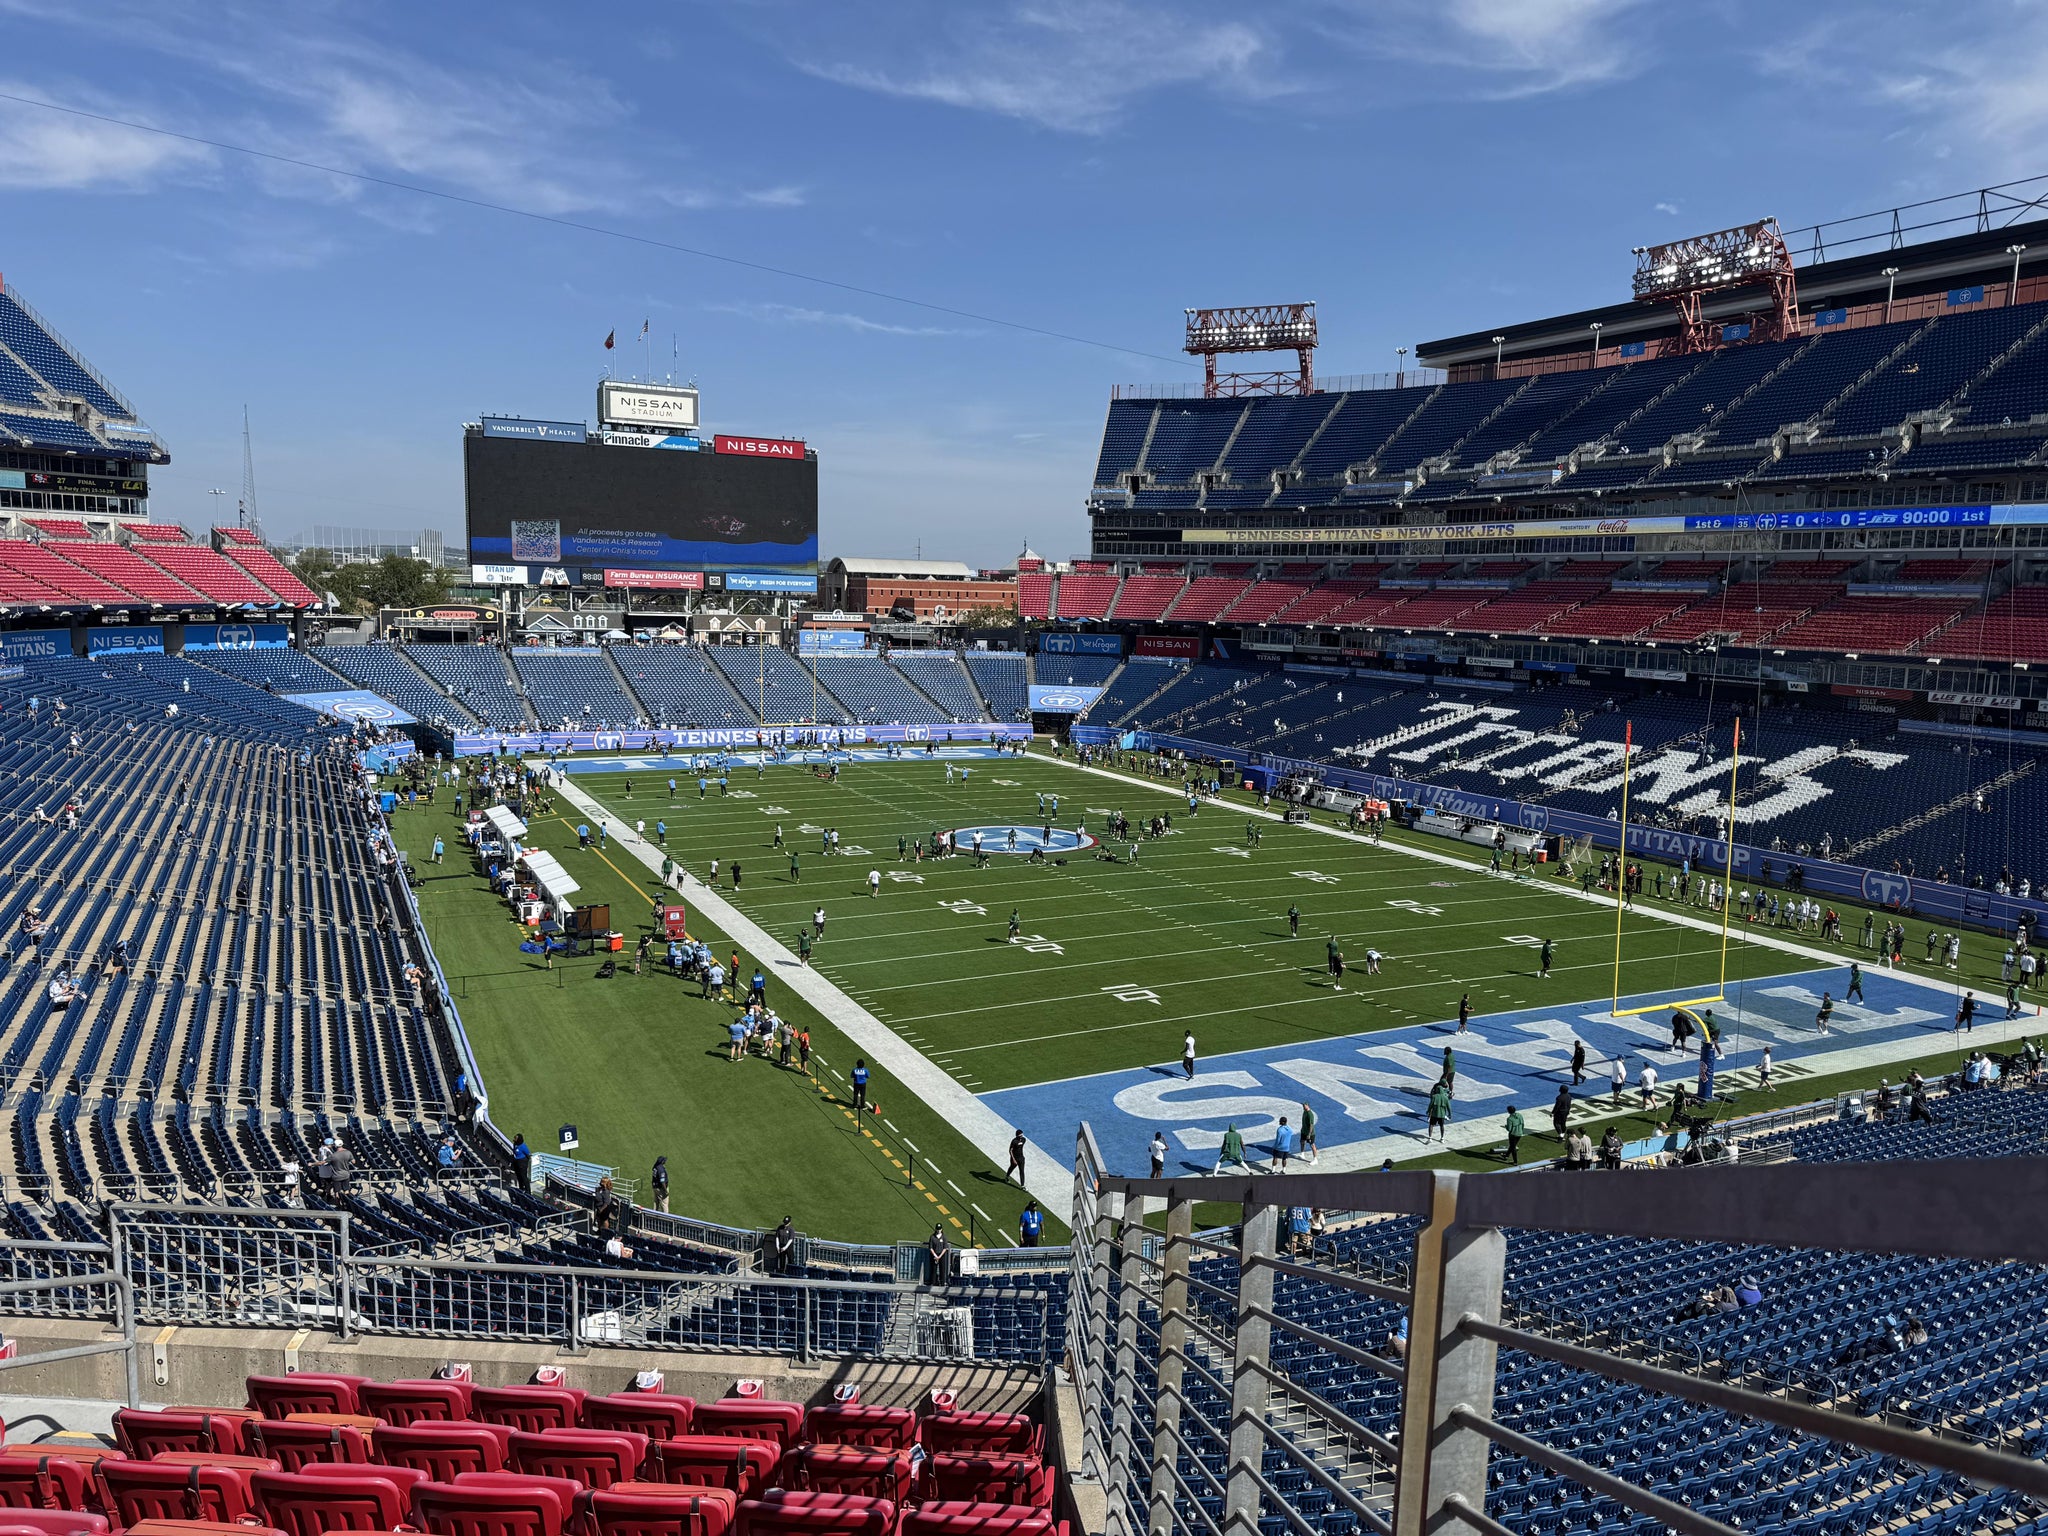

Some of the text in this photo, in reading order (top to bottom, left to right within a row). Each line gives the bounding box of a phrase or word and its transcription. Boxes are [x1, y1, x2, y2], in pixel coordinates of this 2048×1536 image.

[620, 397, 683, 411] NISSAN
[631, 408, 673, 417] STADIUM
[491, 425, 536, 434] VANDERBILT
[604, 432, 650, 446] Pinnacle
[727, 441, 794, 455] NISSAN
[1795, 515, 1805, 528] 0
[1841, 514, 1851, 526] 0
[1867, 512, 1898, 525] JETS
[1902, 511, 1950, 524] 90:00
[1961, 510, 1985, 521] 1st
[1695, 519, 1722, 529] 1st &
[1737, 520, 1749, 528] 35
[1226, 530, 1321, 541] TENNESSEE
[1324, 529, 1383, 541] TITANS
[1398, 527, 1438, 540] NEW
[1436, 525, 1476, 539] YORK
[1477, 524, 1515, 538] JETS
[610, 538, 627, 546] ALS
[627, 539, 663, 547] Research
[610, 547, 636, 555] Chris's
[484, 565, 506, 573] TITAN
[630, 572, 654, 580] Bureau
[11, 635, 46, 643] TENNESSEE
[93, 634, 159, 648] NISSAN
[1091, 637, 1117, 653] Kroger
[1144, 640, 1191, 649] NISSAN
[3, 642, 56, 658] TITANS
[1567, 678, 1591, 686] NORTON
[1855, 689, 1887, 697] NISSAN
[2001, 698, 2018, 706] LEE
[1858, 704, 1896, 714] JOHNSON
[673, 727, 795, 746] TENNESSEE
[1426, 785, 1488, 818] Titans
[1626, 826, 1751, 867] TITAN UP
[1289, 870, 1341, 883] 30
[938, 898, 989, 915] 30
[1384, 900, 1445, 915] 20
[1010, 934, 1065, 953] 20
[1100, 983, 1161, 1002] 10
[564, 1131, 573, 1142] B
[1291, 1208, 1303, 1220] 98
